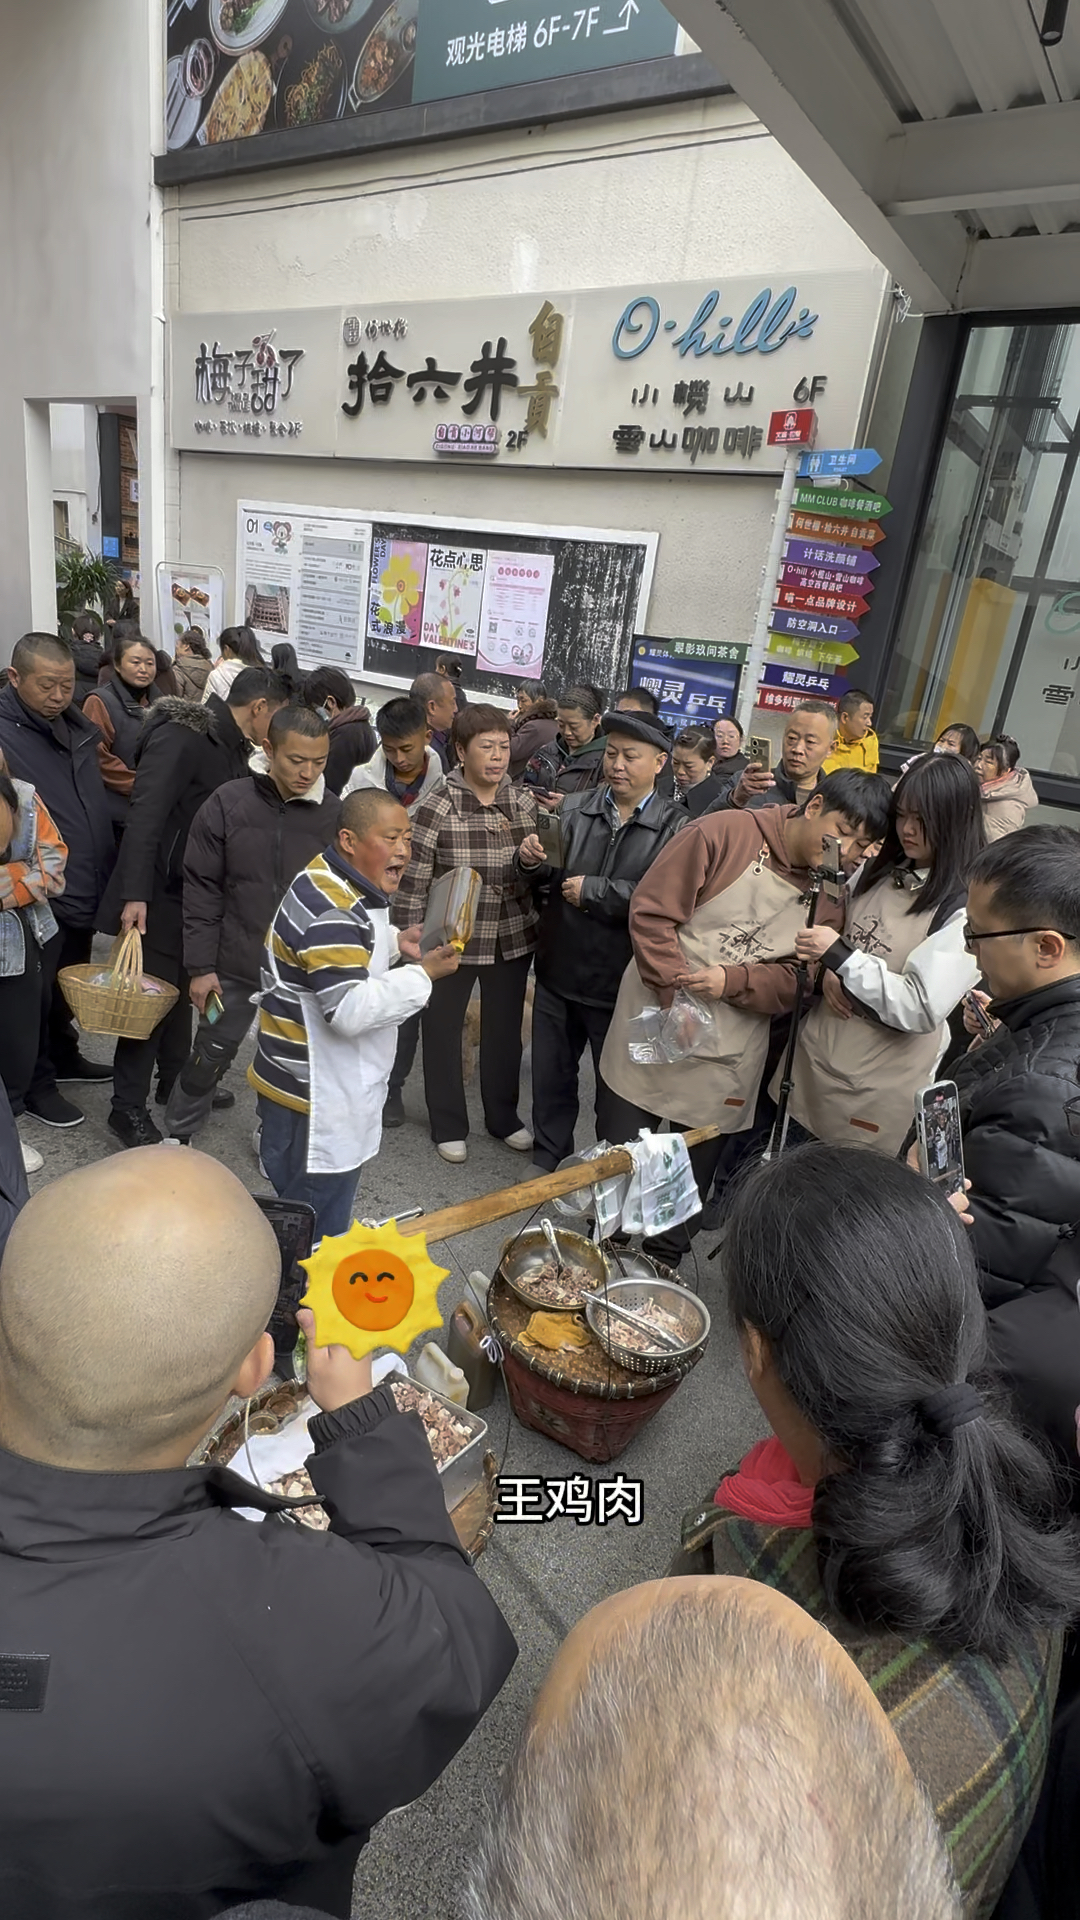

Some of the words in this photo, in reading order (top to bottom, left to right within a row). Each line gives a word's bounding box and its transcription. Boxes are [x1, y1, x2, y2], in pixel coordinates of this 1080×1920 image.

[446, 21, 527, 67] 观光电梯
[533, 6, 600, 48] 6F-7F
[195, 341, 305, 413] 梅子甜了
[341, 337, 519, 421] 拾六井
[793, 375, 828, 403] 6F
[506, 430, 529, 450] 2F
[828, 454, 857, 466] 卫生间
[800, 493, 815, 504] MM
[816, 495, 839, 507] CLUB
[246, 518, 259, 534] 01
[380, 538, 388, 558] DAY
[430, 548, 484, 572] 花点心思
[424, 622, 440, 634] DAY
[786, 617, 838, 635] 防空洞入口
